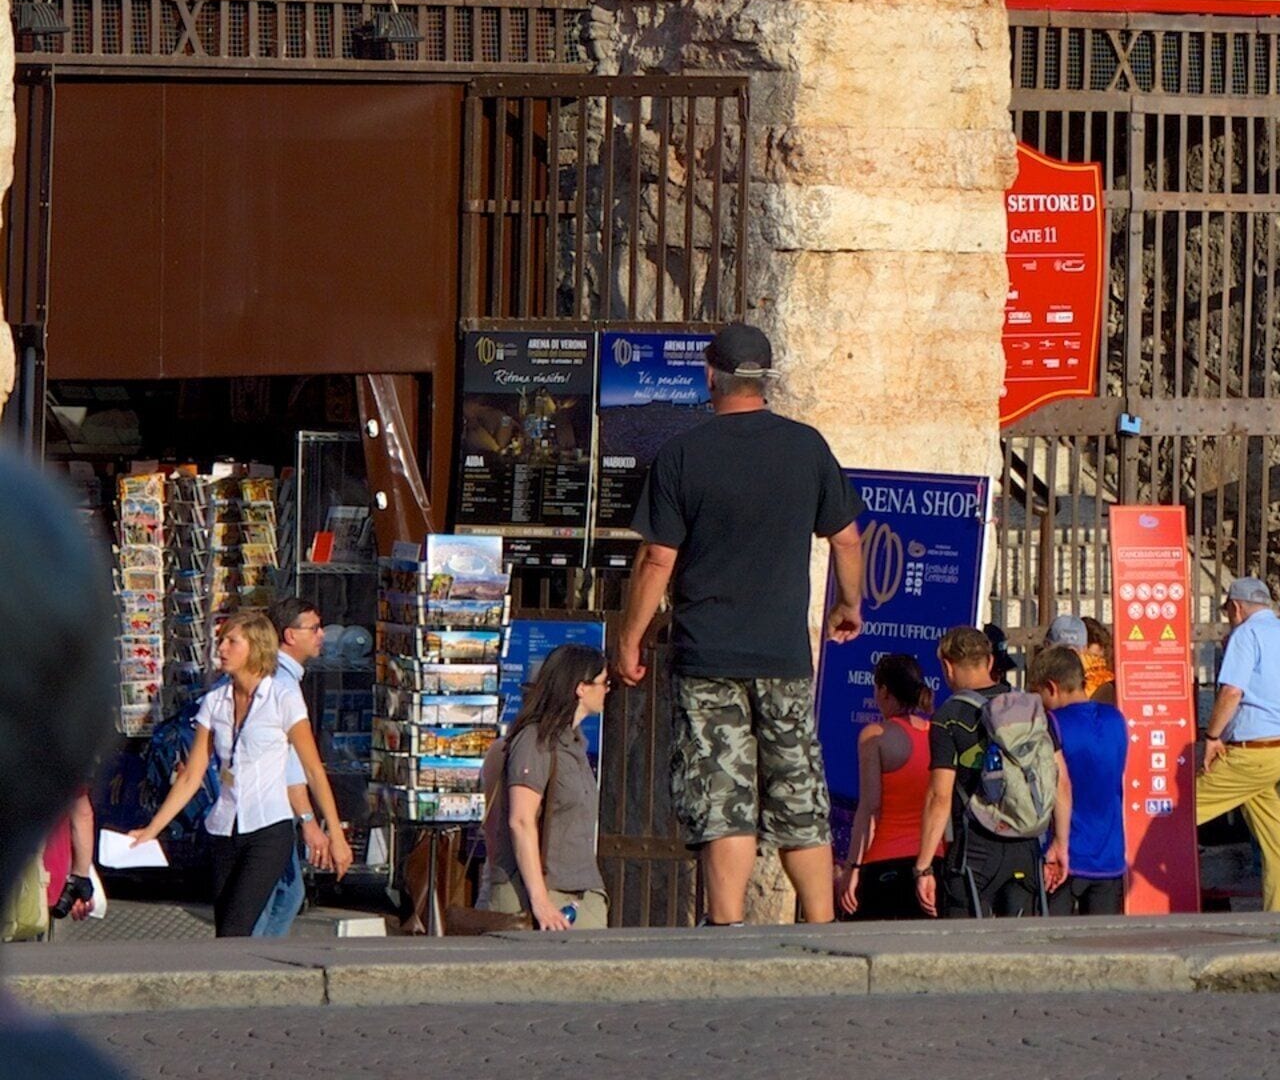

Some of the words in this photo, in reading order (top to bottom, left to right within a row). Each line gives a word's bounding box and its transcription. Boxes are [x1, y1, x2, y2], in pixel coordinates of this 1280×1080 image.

[1008, 194, 1079, 213] SETTORE
[1083, 194, 1096, 212] D
[1010, 228, 1042, 244] GATE
[1044, 227, 1058, 243] 11
[861, 486, 918, 515] RENA
